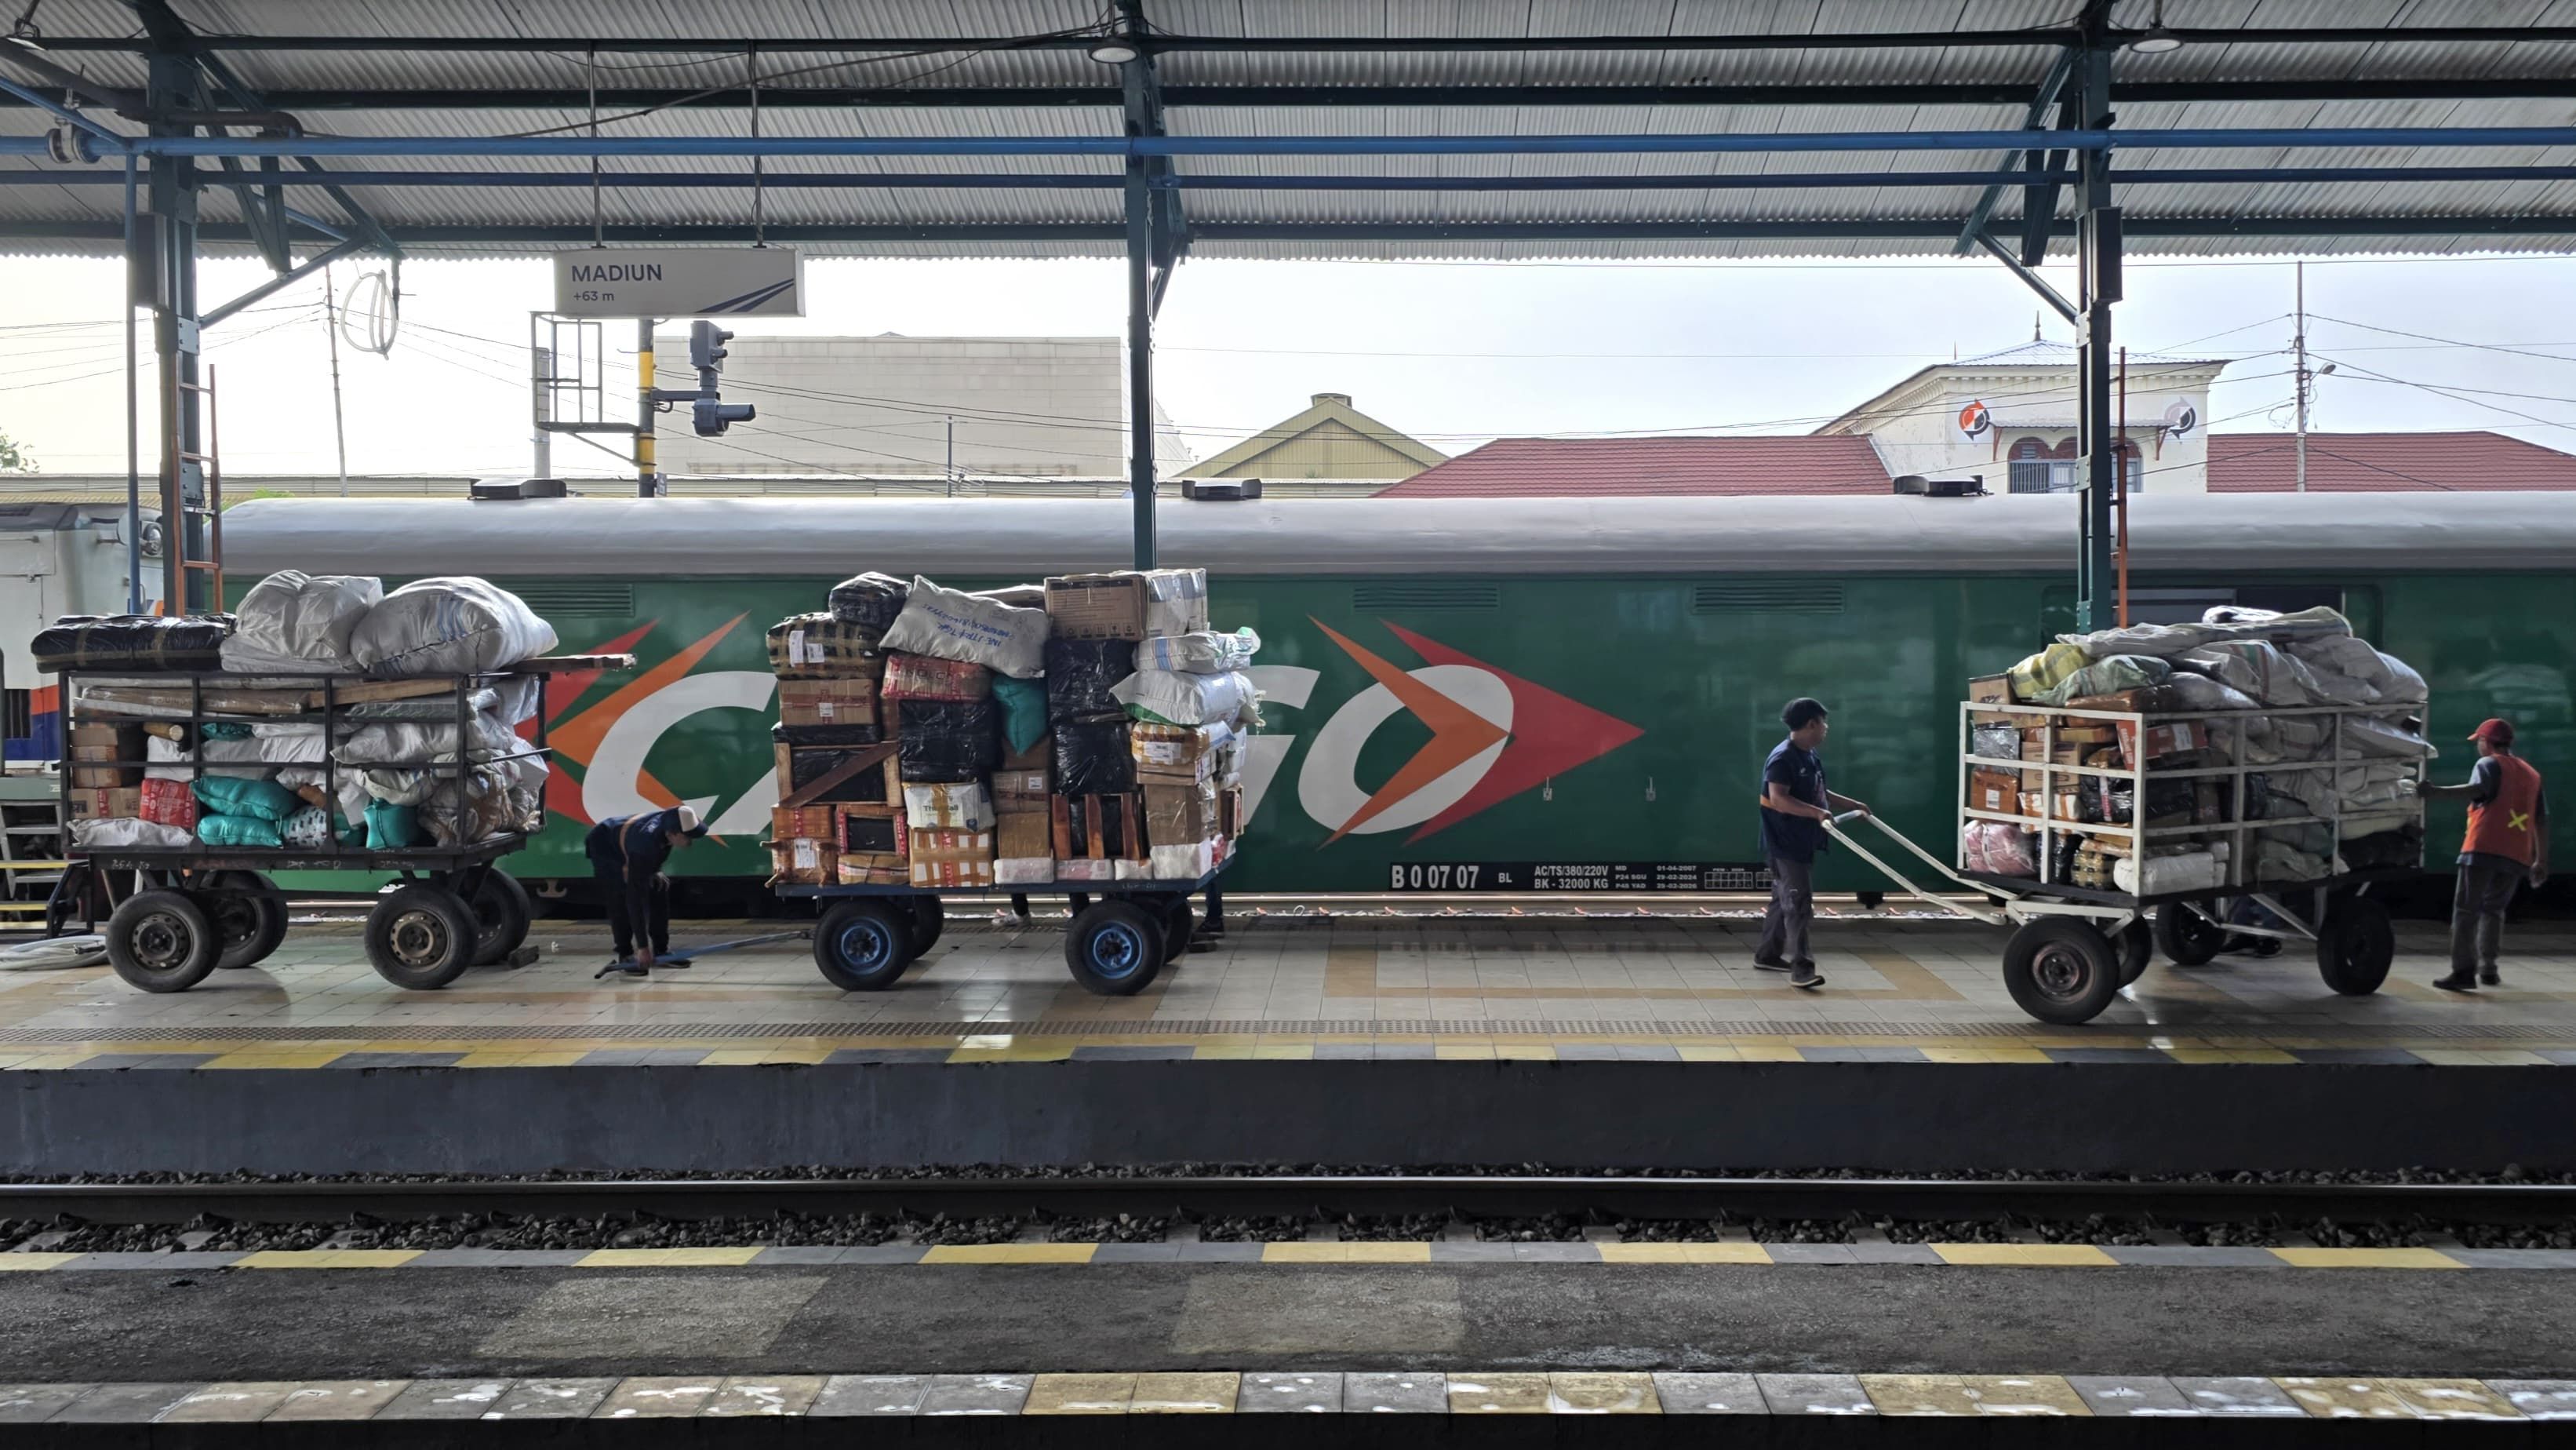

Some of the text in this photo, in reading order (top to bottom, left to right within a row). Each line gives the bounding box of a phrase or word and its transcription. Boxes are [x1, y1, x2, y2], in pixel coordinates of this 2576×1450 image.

[571, 264, 662, 282] MADIUN
[573, 290, 615, 302] +63 m
[1392, 865, 1479, 889] B 0 07 07
[1534, 865, 1609, 877] AC/TS/380/220V
[1498, 873, 1512, 883] BL
[1534, 878, 1549, 889] BK
[1559, 878, 1591, 889] 32000
[1593, 878, 1609, 889] KG
